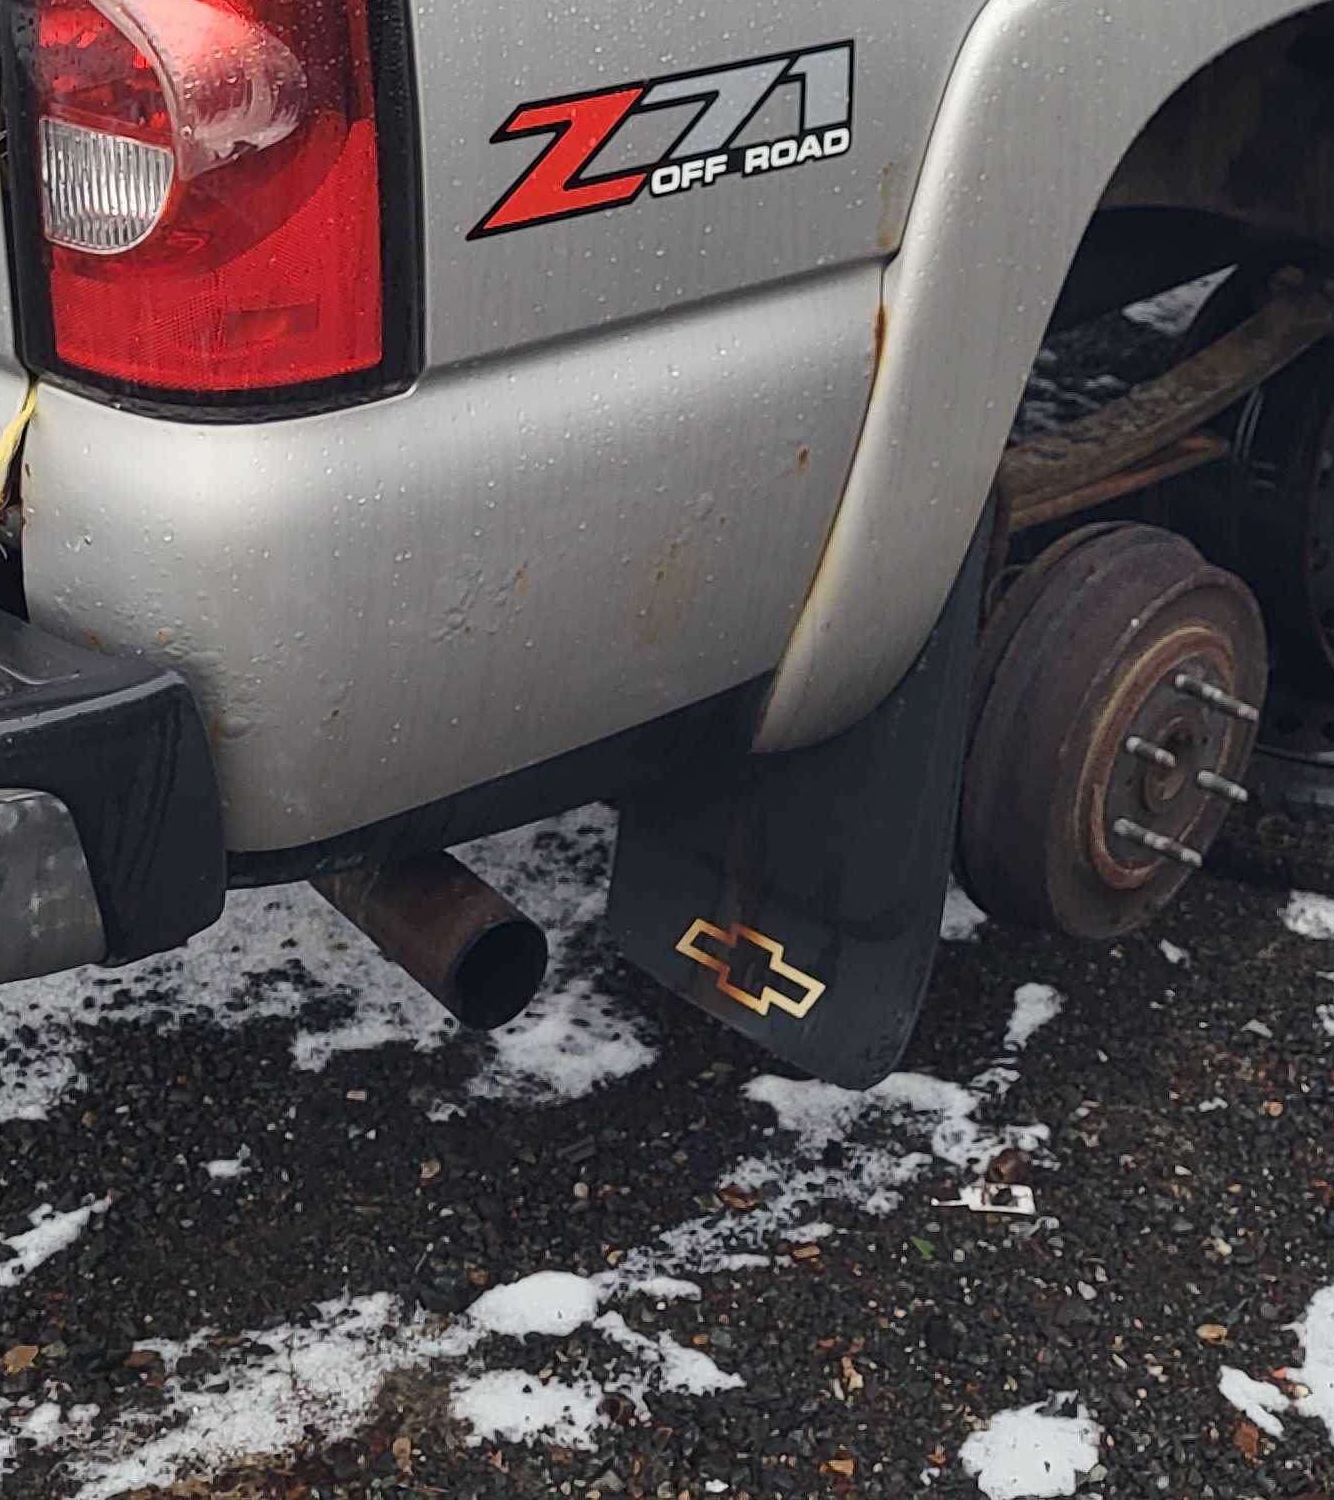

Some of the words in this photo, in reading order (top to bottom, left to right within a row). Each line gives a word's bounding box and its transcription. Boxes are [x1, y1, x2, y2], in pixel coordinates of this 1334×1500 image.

[467, 39, 855, 241] Z71
[648, 153, 729, 198] OFF
[743, 126, 852, 176] ROAD
